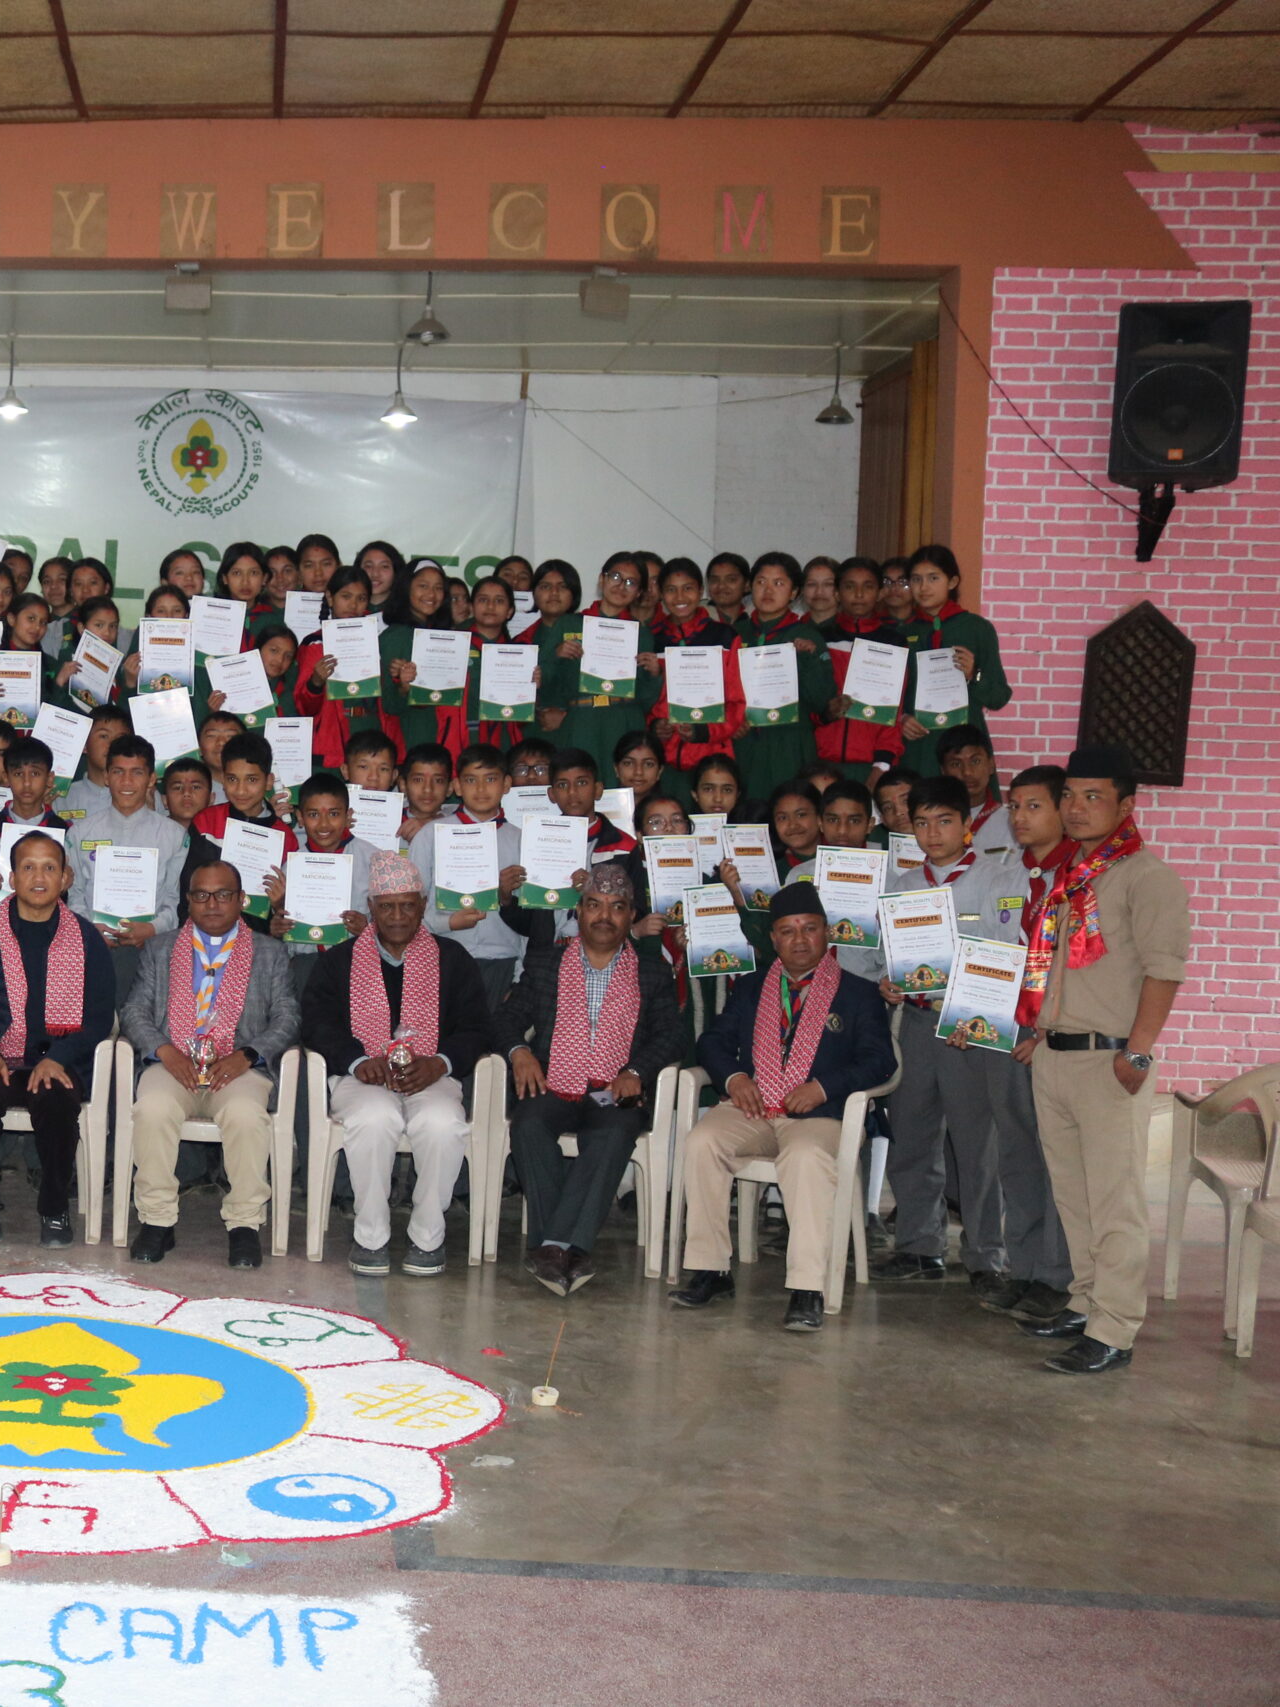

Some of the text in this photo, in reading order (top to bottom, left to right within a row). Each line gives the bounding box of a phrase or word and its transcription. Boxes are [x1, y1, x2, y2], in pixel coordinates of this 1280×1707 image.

[167, 190, 876, 257] WELCOME
[251, 441, 262, 467] 1952
[138, 468, 259, 516] NEPAL SCOUTS
[830, 872, 870, 880] CERTIFICATE
[895, 915, 939, 925] CERTIFICATE
[967, 964, 1013, 977] CERTIFICATE
[50, 1601, 358, 1671] CAMP
